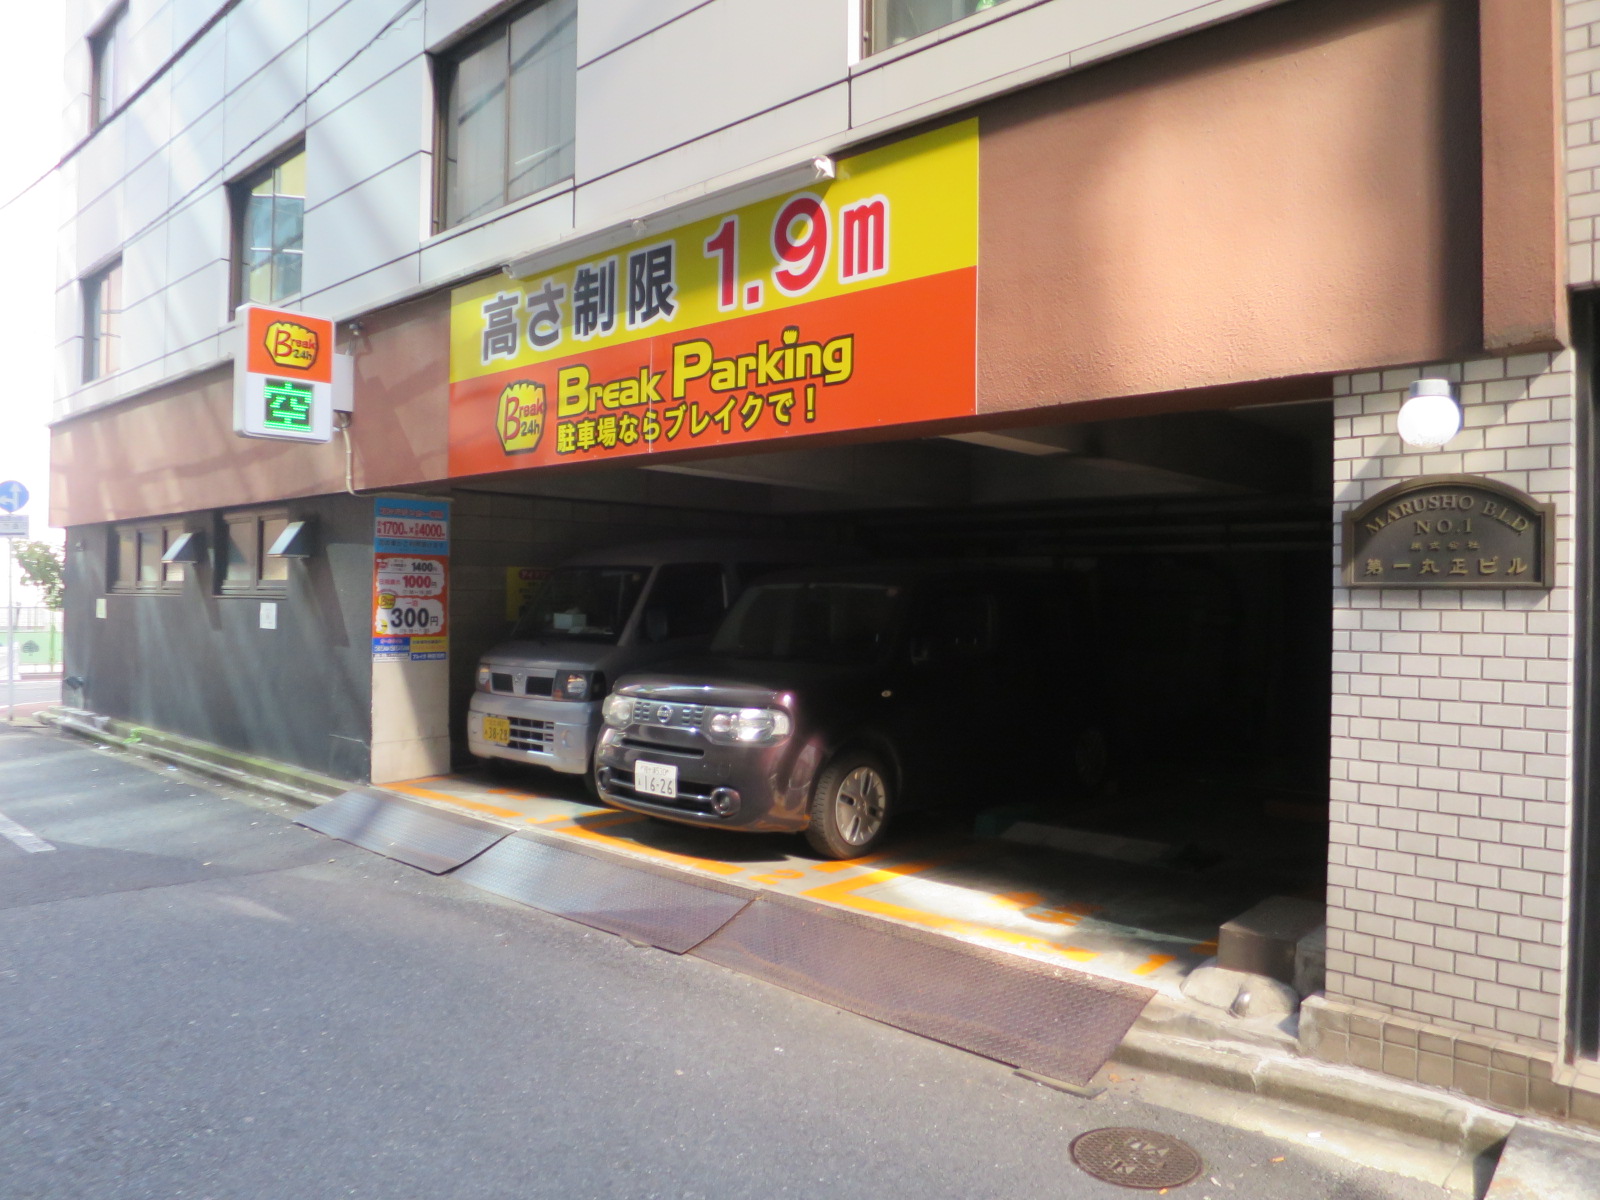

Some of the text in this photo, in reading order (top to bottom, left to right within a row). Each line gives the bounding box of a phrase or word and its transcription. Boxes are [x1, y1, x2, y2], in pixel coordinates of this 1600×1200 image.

[482, 196, 886, 362] 高さ制限 1.9m
[275, 328, 315, 357] Break
[293, 349, 312, 360] 24h
[557, 326, 854, 418] Break Parking
[504, 395, 544, 444] Break
[520, 420, 540, 436] 24h
[1365, 494, 1474, 536] MARUSHO
[1364, 554, 1529, 577] 第一丸正ビル
[644, 775, 673, 795] 16-26
